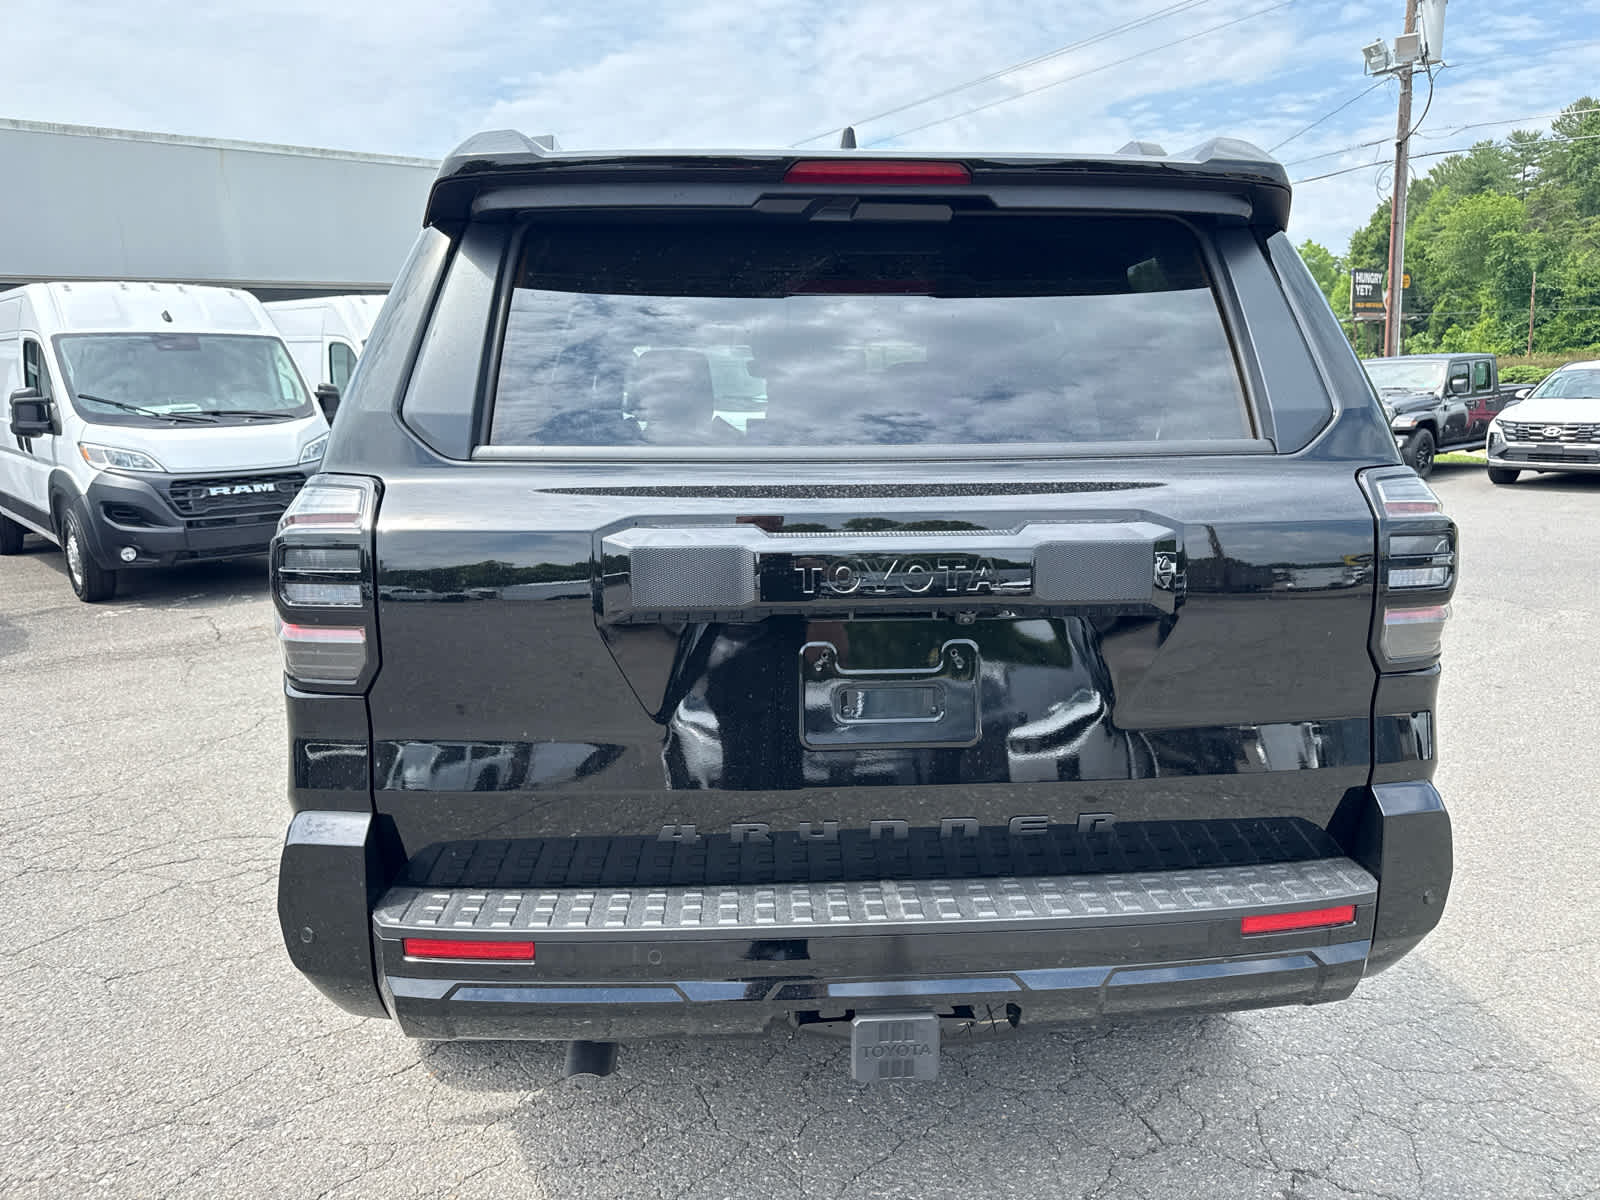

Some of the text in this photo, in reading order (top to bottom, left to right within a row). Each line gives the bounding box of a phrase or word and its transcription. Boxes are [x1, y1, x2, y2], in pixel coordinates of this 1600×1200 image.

[1355, 272, 1383, 284] HUNGRY
[1355, 284, 1373, 296] YET?
[209, 483, 275, 496] RAM
[794, 557, 1001, 594] TOYOTA
[861, 1043, 932, 1058] TOYOTA
